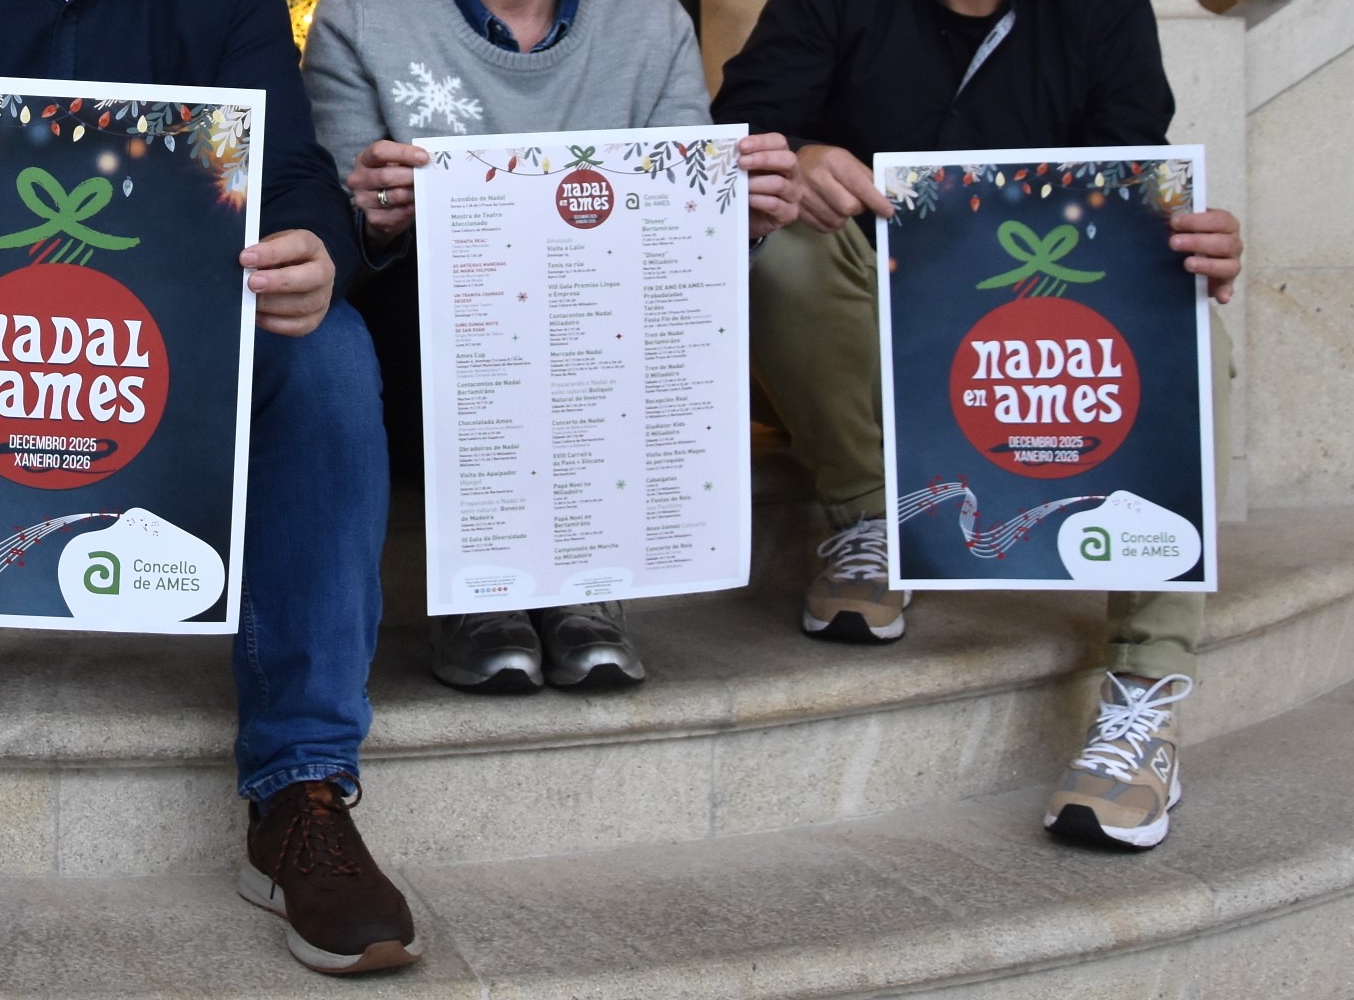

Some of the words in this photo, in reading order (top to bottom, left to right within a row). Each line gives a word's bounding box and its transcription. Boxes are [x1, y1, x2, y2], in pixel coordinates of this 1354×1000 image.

[963, 389, 988, 407] en
[9, 434, 66, 452] DECEMBRO
[68, 436, 97, 452] 2025
[1008, 436, 1057, 448] DECEMBRO
[1059, 436, 1084, 448] 2025
[14, 452, 60, 468] XANEIRO
[62, 454, 90, 469] 2026
[1014, 450, 1053, 462] XANEIRO
[1055, 450, 1080, 462] 2026
[1121, 532, 1176, 544] Concello
[1122, 546, 1138, 558] de
[1141, 546, 1180, 558] AMES
[133, 558, 197, 576] Concello
[133, 576, 152, 590] de
[155, 576, 200, 592] AMES
